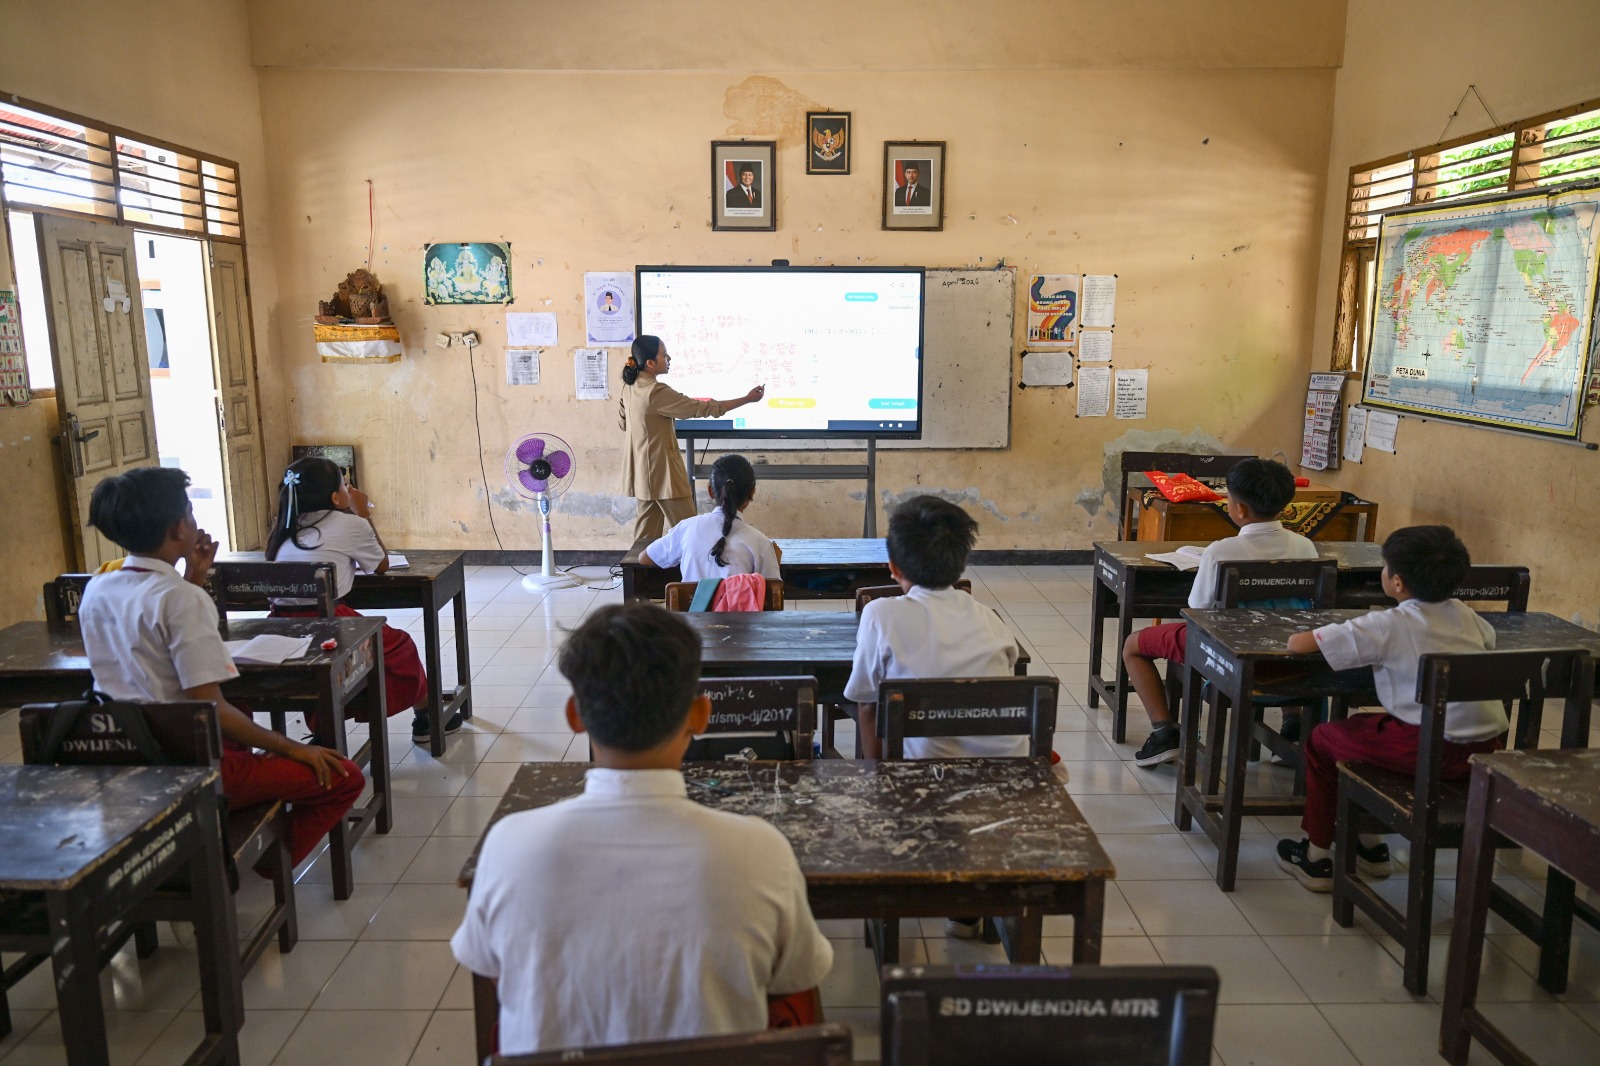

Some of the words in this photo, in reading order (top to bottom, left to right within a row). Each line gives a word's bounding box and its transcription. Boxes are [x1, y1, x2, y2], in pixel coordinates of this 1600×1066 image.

[1395, 366, 1409, 374] PETA
[1410, 368, 1426, 377] DUNIA
[1251, 578, 1296, 586] DWIJENDRA
[909, 710, 925, 720] SD
[928, 708, 997, 719] DWIJENDRA
[940, 998, 972, 1017] SD
[976, 999, 1107, 1016] DWIJENDRA
[1111, 998, 1160, 1017] MTR
